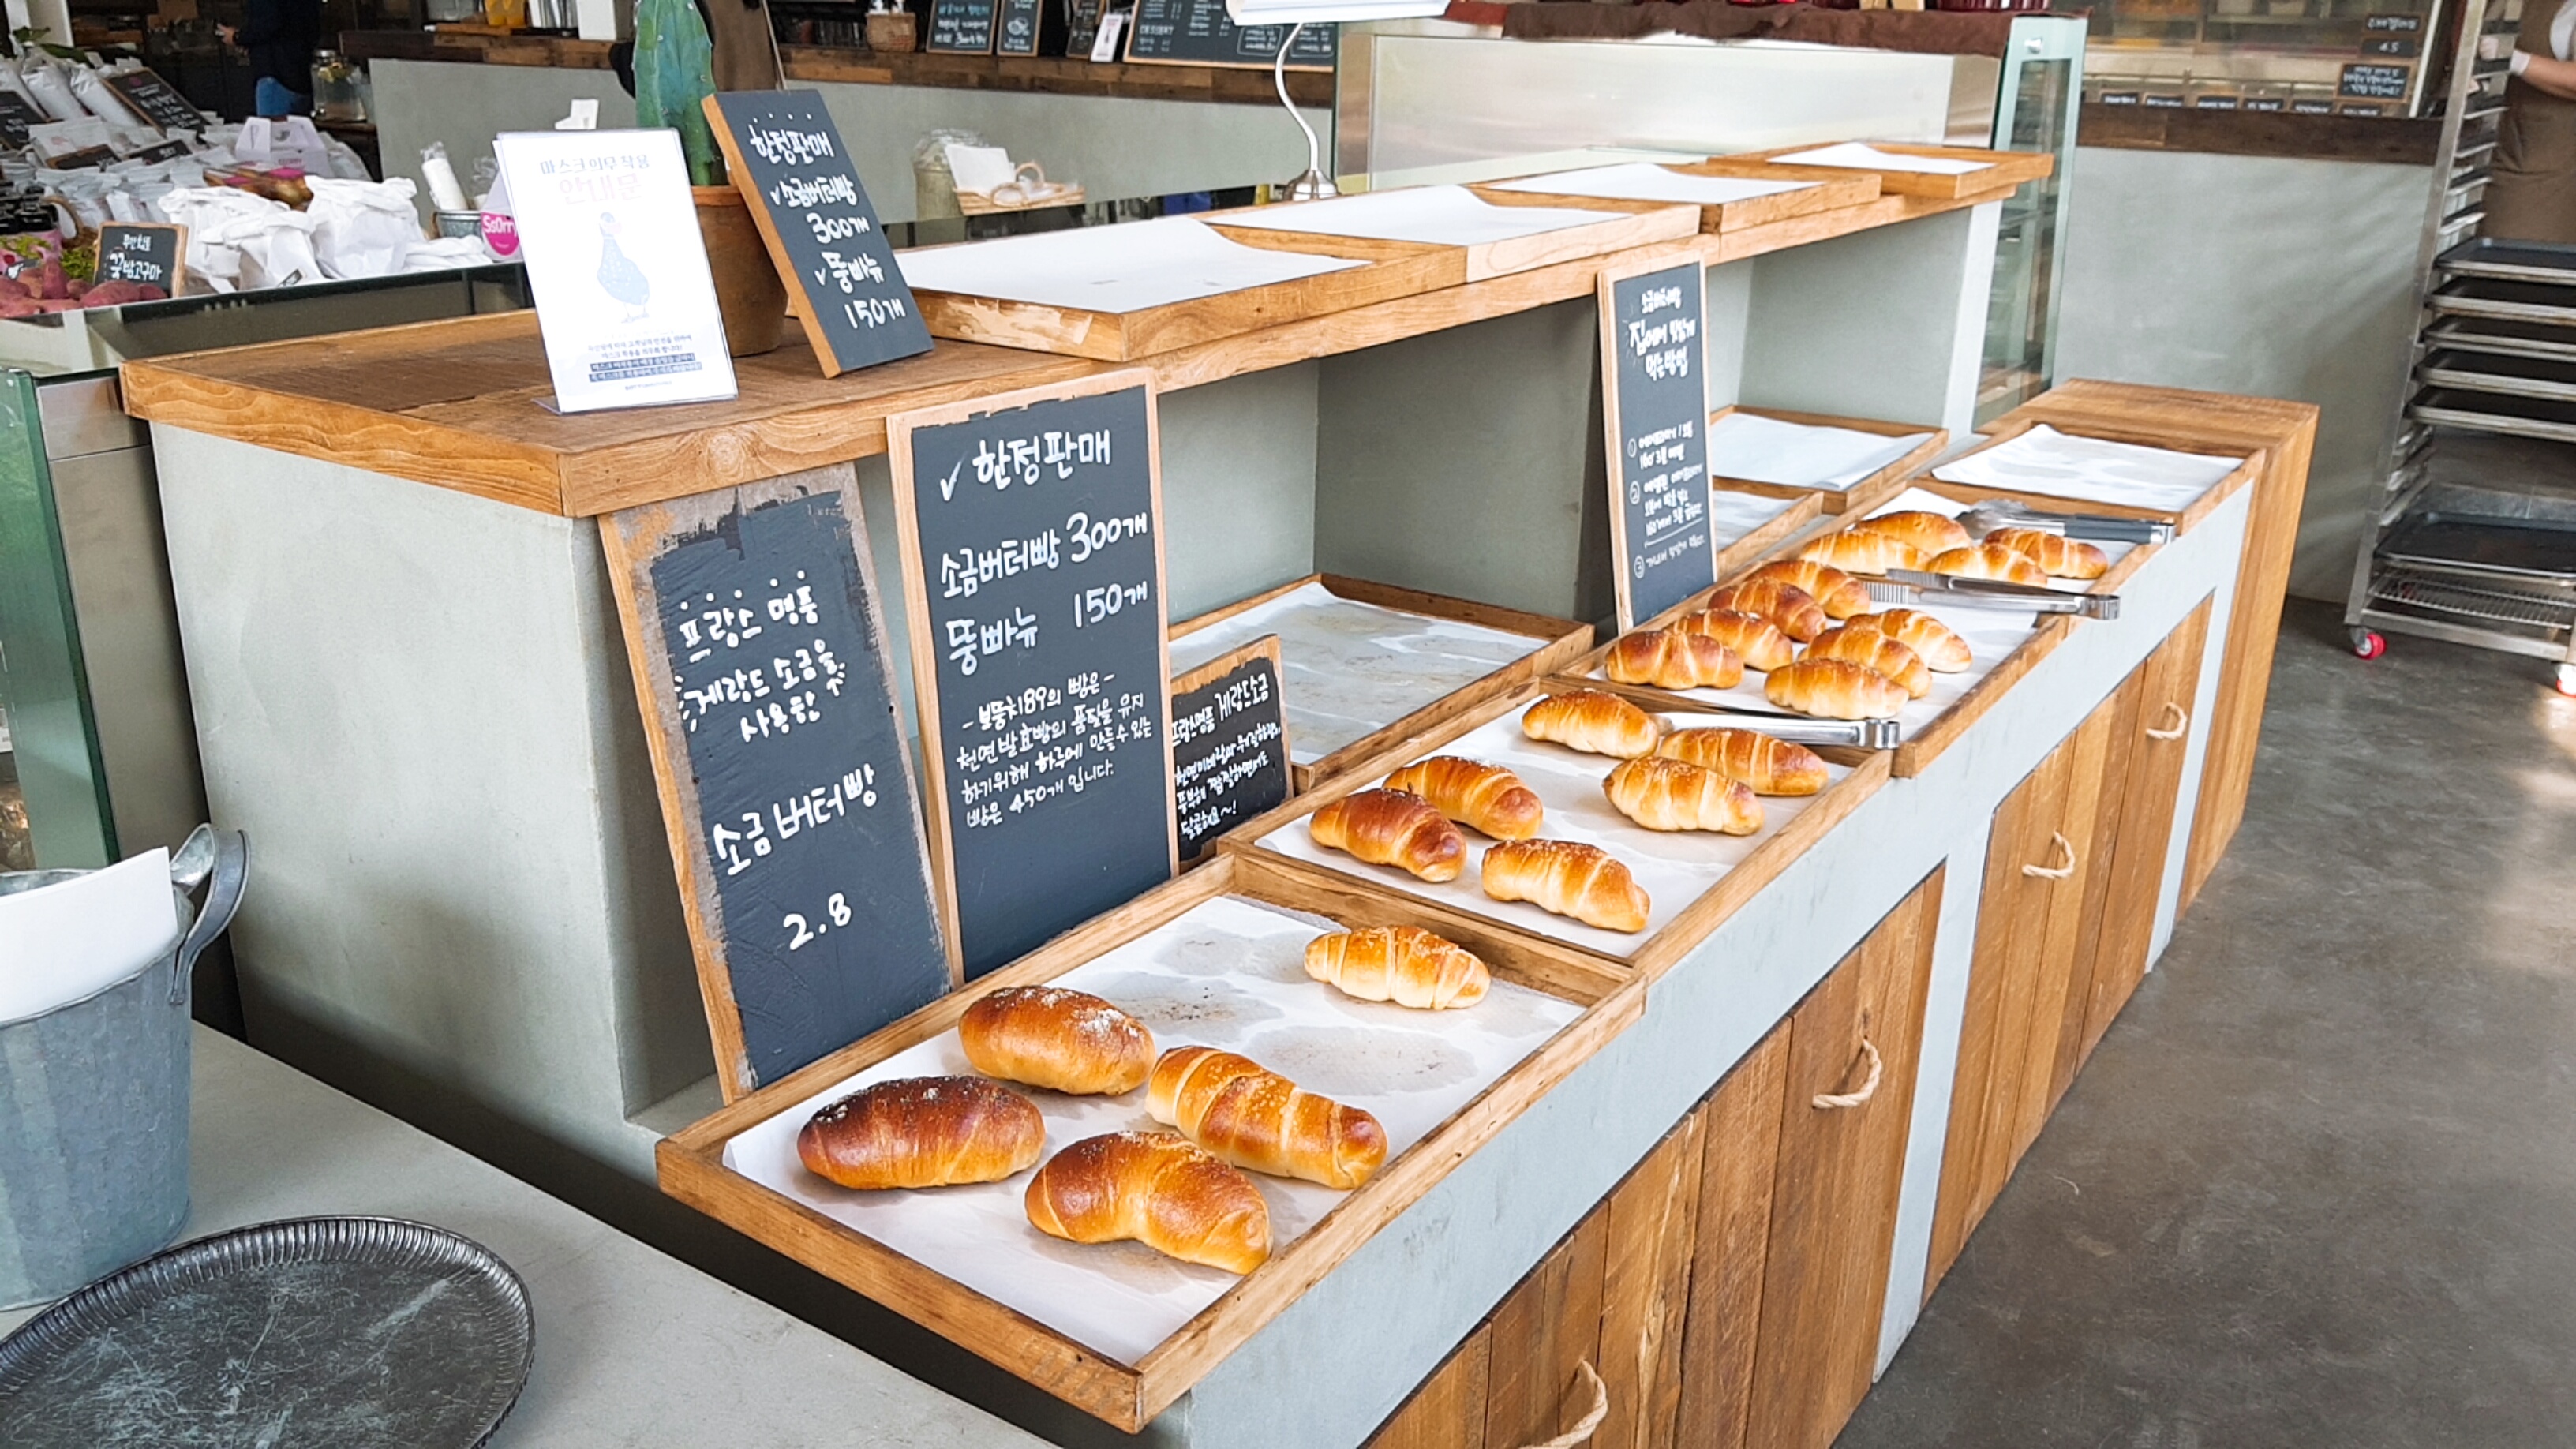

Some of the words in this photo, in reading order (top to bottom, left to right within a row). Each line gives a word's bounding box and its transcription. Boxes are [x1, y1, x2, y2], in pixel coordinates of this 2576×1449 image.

[749, 124, 835, 165] 한정판매
[540, 158, 586, 174] 마스크
[560, 172, 642, 205] 안내문
[779, 174, 857, 208] 소금버터빵
[806, 212, 870, 245] 300개
[844, 298, 906, 328] 150개
[972, 429, 1110, 490] 한정판매
[941, 528, 1061, 598] 소금버터빵
[1066, 512, 1148, 563] 300개
[1074, 581, 1148, 628] 150개
[680, 607, 762, 663] 프랑스
[768, 586, 818, 625] 명품
[684, 669, 770, 715] 게랑드
[773, 638, 838, 691] 소금을
[1068, 672, 1100, 699] 빵은
[1118, 692, 1144, 720] 유지
[1035, 742, 1084, 773] 하루에
[967, 801, 1003, 828] 빵은
[1009, 778, 1064, 814] 450개
[782, 893, 852, 951] 2.8
